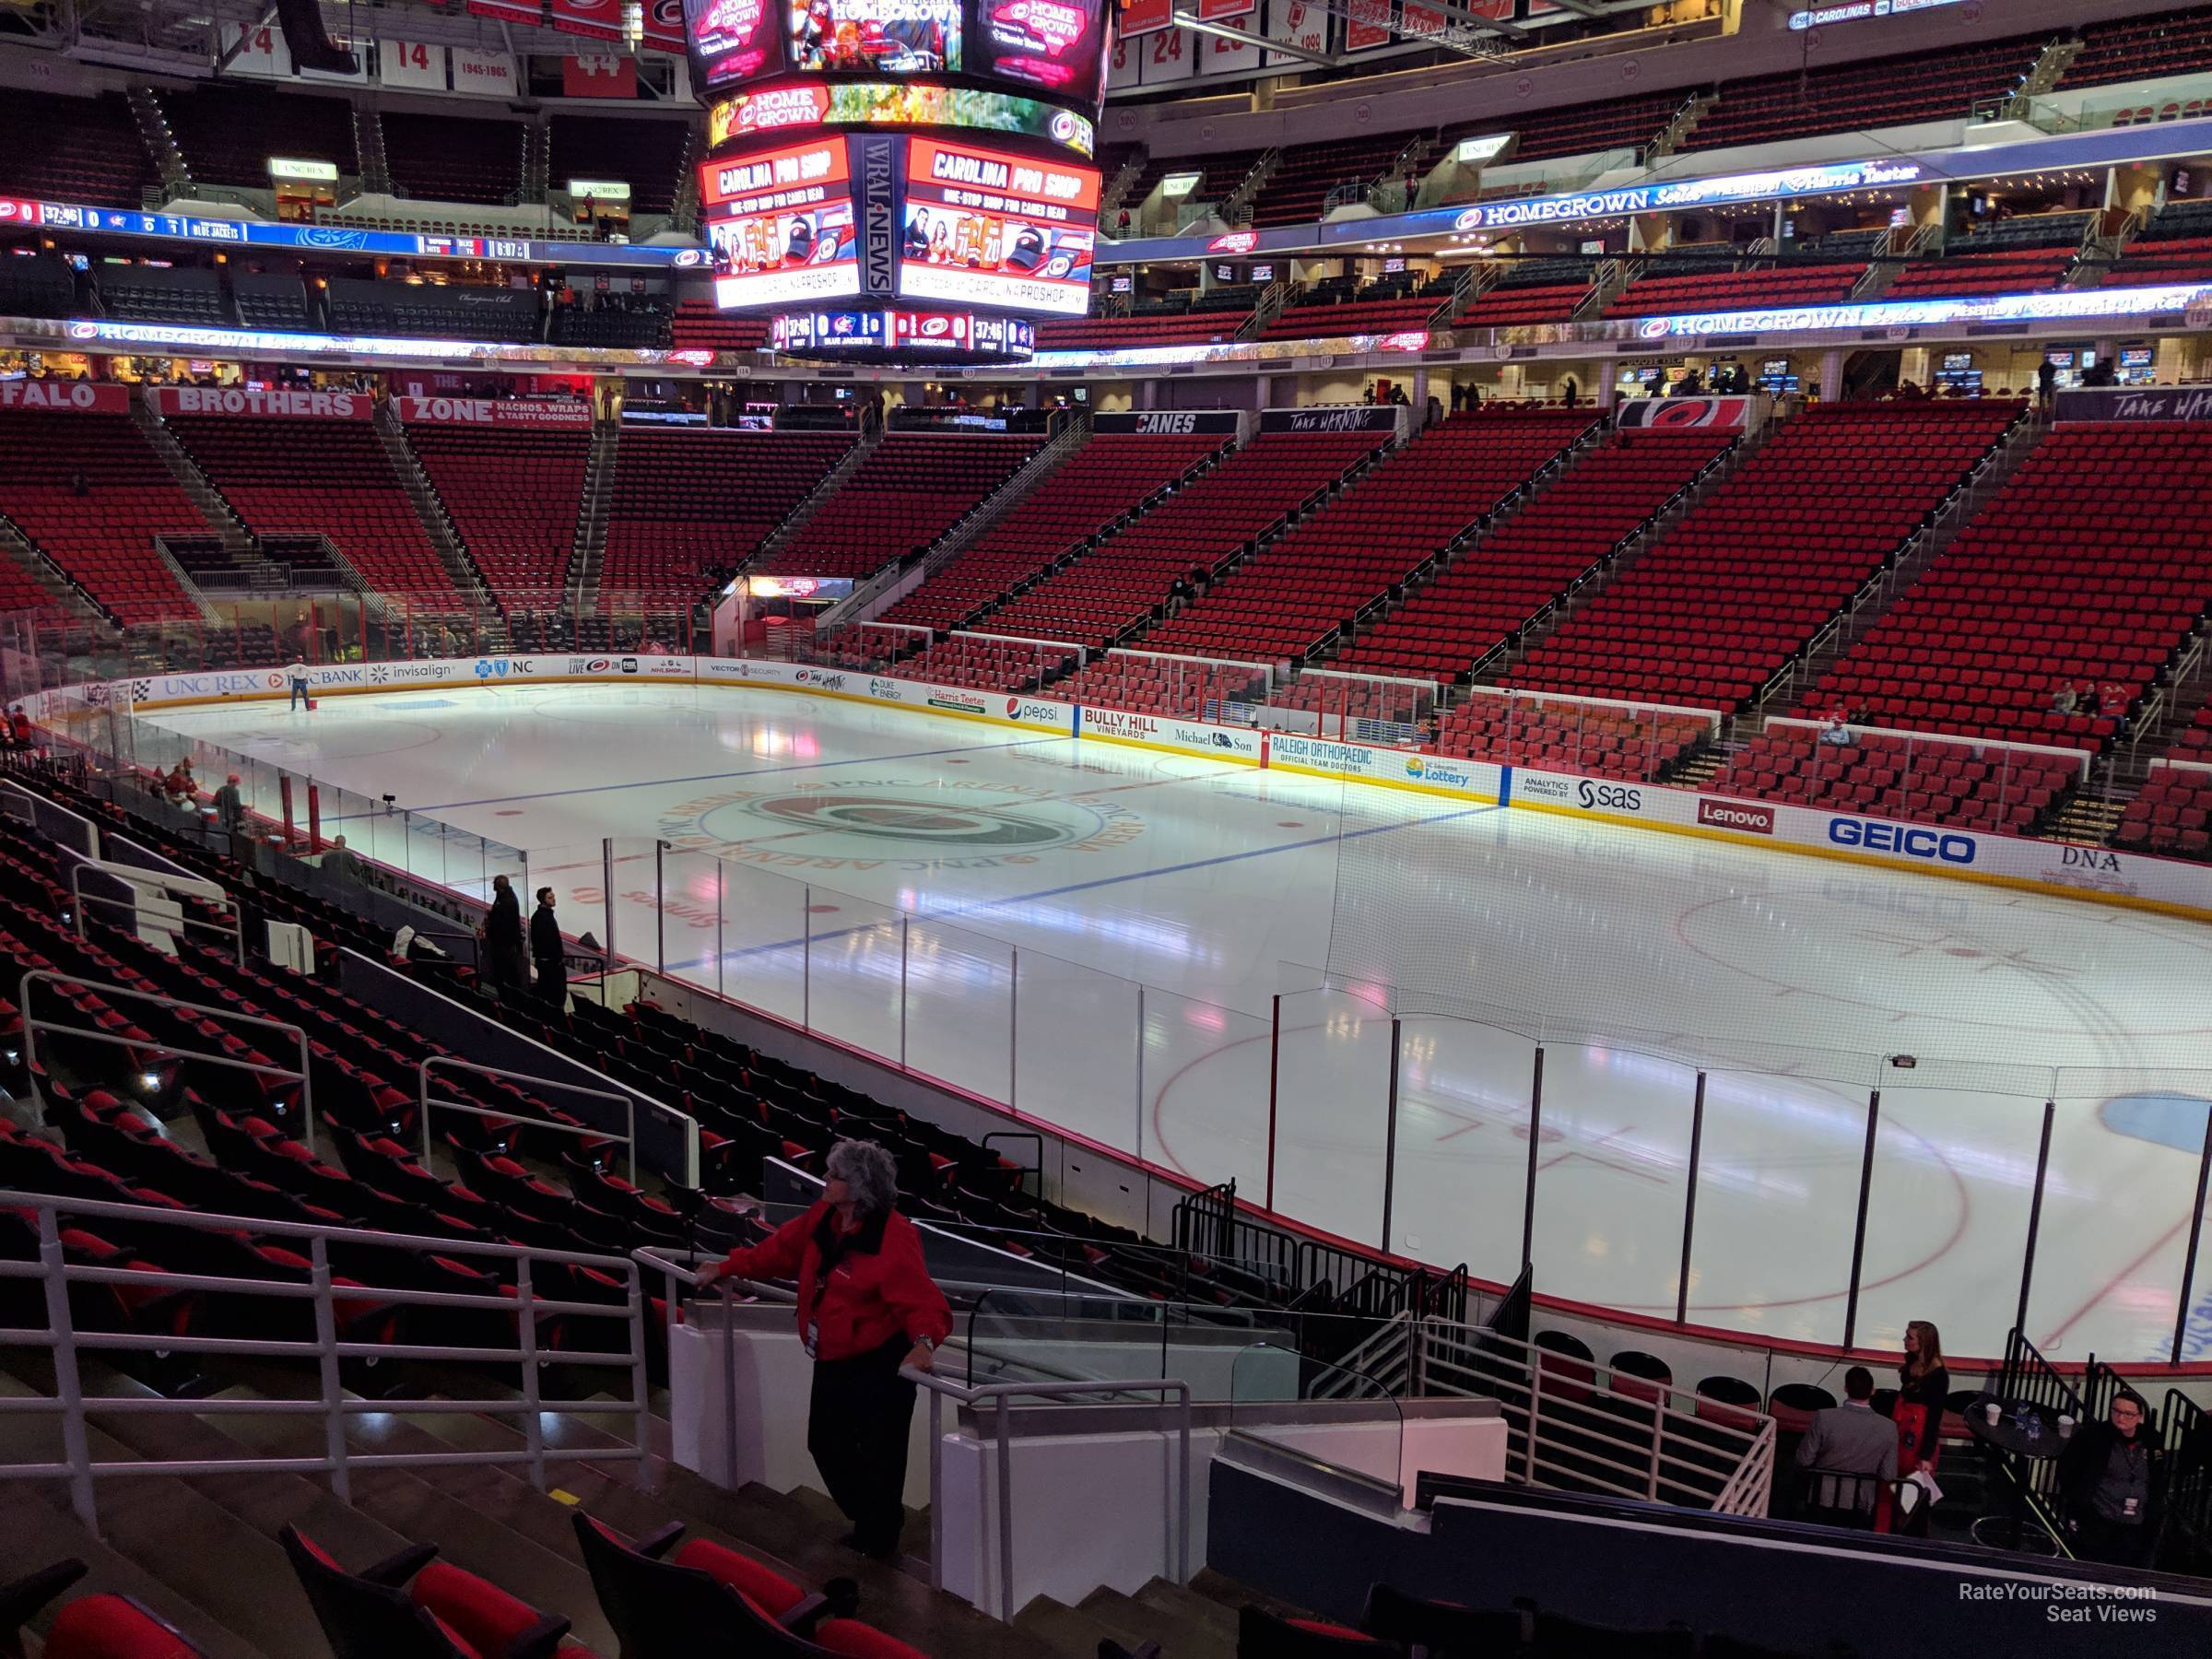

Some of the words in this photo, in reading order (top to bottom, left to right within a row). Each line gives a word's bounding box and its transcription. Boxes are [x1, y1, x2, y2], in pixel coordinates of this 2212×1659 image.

[722, 6, 760, 26] GROWN
[1030, 0, 1076, 22] HOME
[1815, 5, 1871, 23] CAROLINAS
[1030, 16, 1077, 36] GROWN
[398, 41, 429, 69] 14
[1154, 29, 1182, 64] 24
[757, 89, 814, 112] HOME
[757, 106, 819, 126] GROWN
[720, 162, 773, 194] CAROLINA
[775, 158, 799, 183] PRO
[865, 141, 892, 208] WRAL
[934, 152, 1008, 188] CAROLINA
[1013, 167, 1042, 194] PRO
[1044, 172, 1081, 199] SHOP
[21, 204, 33, 221] 0
[46, 206, 78, 222] 37:46
[1487, 190, 1649, 225] HOMEGROWN
[88, 211, 100, 228] 0
[145, 221, 155, 231] 0
[193, 224, 210, 237] BLUE
[211, 227, 238, 239] JACKETS
[1227, 233, 1252, 241] HOME
[497, 242, 516, 257] 6:07
[869, 211, 891, 289] NEWS
[984, 237, 1002, 263] 20
[1227, 240, 1253, 249] GROWN
[818, 315, 829, 336] 0
[898, 319, 907, 333] 0
[953, 317, 965, 338] 0
[1677, 307, 1864, 335] HOMEGROWN
[975, 322, 1003, 341] 37:46
[1007, 323, 1016, 343] 0
[1398, 339, 1425, 347] GROWN
[433, 374, 459, 388] THE
[179, 387, 354, 417] BROTHERS
[414, 399, 494, 422] ZONE
[497, 403, 547, 413] NACHOS,
[547, 404, 590, 414] WRAPS
[2113, 393, 2167, 418] TAKE
[505, 412, 538, 420] TASTY
[539, 413, 590, 422] GOODNESS
[1135, 414, 1196, 433] CANES
[1289, 414, 1316, 431] TAKE
[1319, 409, 1372, 432] WARNING
[394, 662, 451, 678] invisalign
[512, 660, 534, 674] NC
[569, 664, 584, 675] LIVE
[611, 662, 620, 670] ON
[711, 665, 739, 673] VECTOR
[750, 667, 782, 677] SECURITY
[165, 677, 208, 695] UNC
[216, 674, 260, 691] REX
[323, 669, 362, 684] BANK
[880, 679, 895, 689] DUKE
[880, 688, 901, 700] ENERGY
[935, 688, 959, 701] Harris
[960, 693, 985, 706] Teeter
[1024, 706, 1057, 722] pepsi
[1085, 709, 1124, 726] BULLY
[1128, 716, 1159, 734] HILL
[1096, 724, 1146, 740] VINEYARDS
[1175, 728, 1211, 746] Michael
[1233, 737, 1253, 752] Son
[1272, 738, 1309, 757] RALEIGH
[1311, 743, 1372, 765] ORTHOPAEDIC
[1280, 754, 1310, 766] OFFICIAL
[1311, 758, 1329, 768] TEAM
[1330, 760, 1362, 773] DOCTORS
[1425, 767, 1469, 787] Lottery
[1524, 777, 1569, 791] ANALYTICS
[830, 779, 912, 788] PNC
[923, 780, 1055, 797] ARENA
[1524, 785, 1558, 797] POWERED
[1559, 790, 1568, 798] BY
[1597, 784, 1641, 811] sas
[1703, 804, 1768, 828] Lenovo
[1829, 818, 1976, 865] GEICO
[900, 857, 1004, 872] PNC
[2062, 846, 2121, 872] DNA
